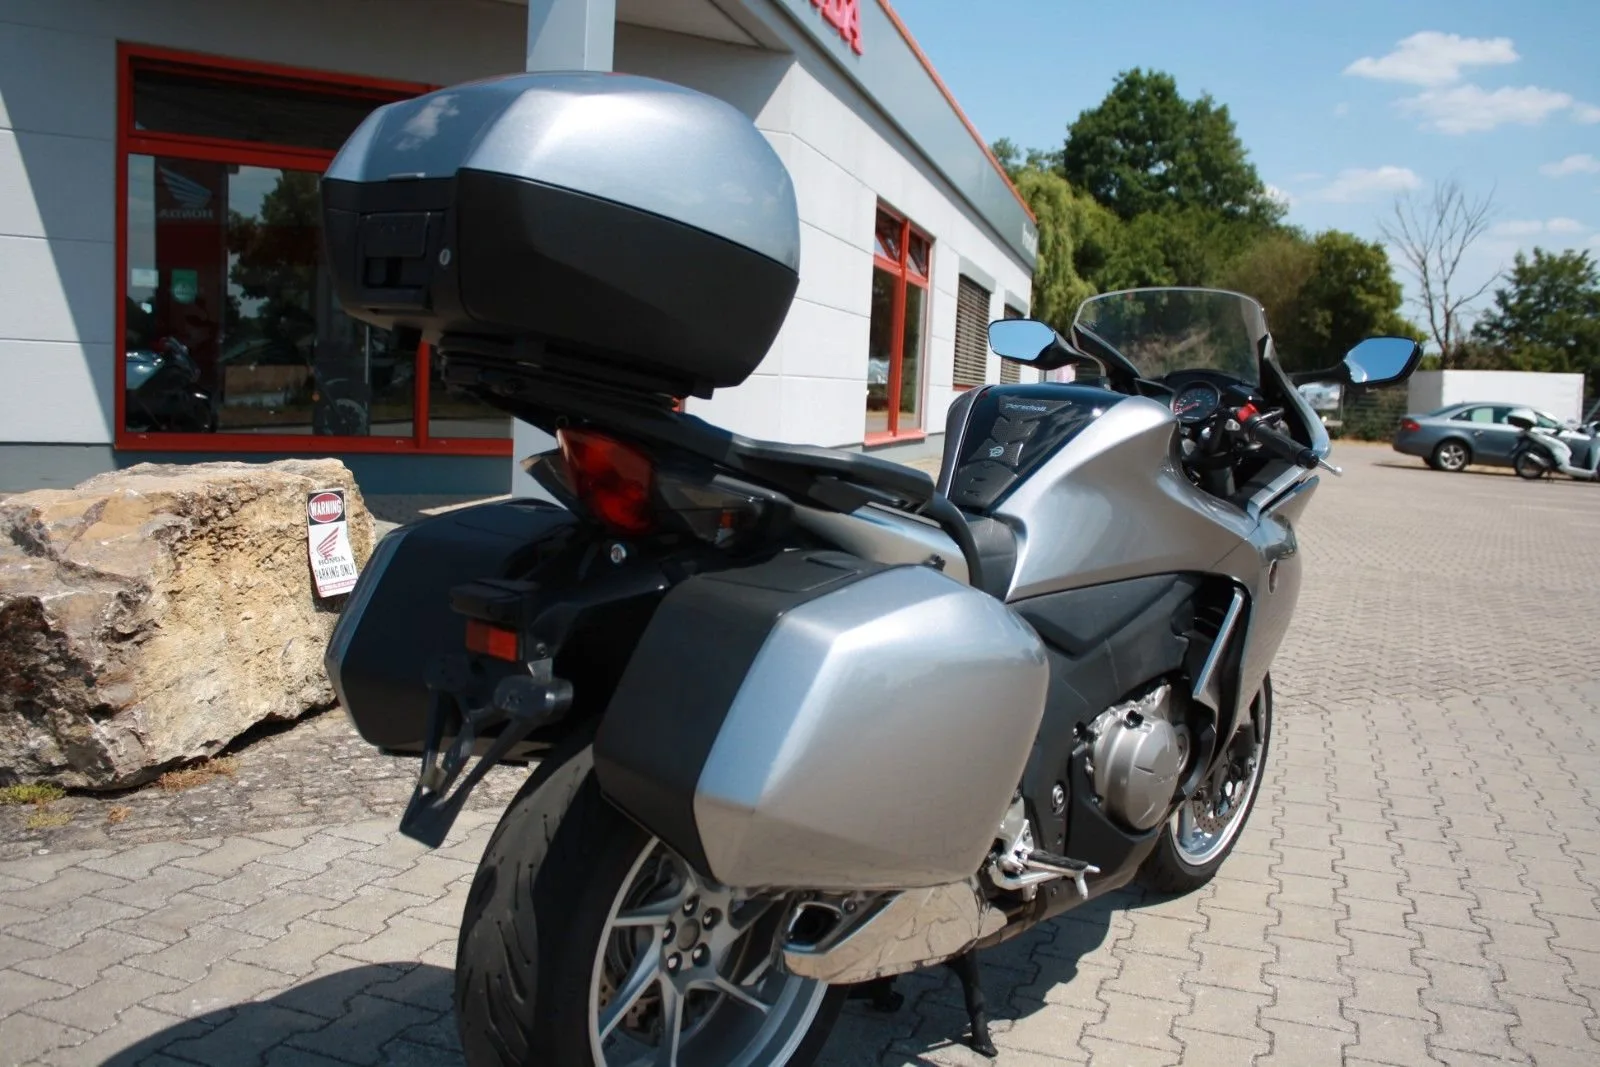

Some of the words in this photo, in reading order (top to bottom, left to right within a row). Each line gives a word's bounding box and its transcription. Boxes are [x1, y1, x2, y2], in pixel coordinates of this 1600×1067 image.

[310, 500, 342, 516] WARNING
[318, 556, 346, 566] HONDA
[340, 562, 355, 577] ONLY
